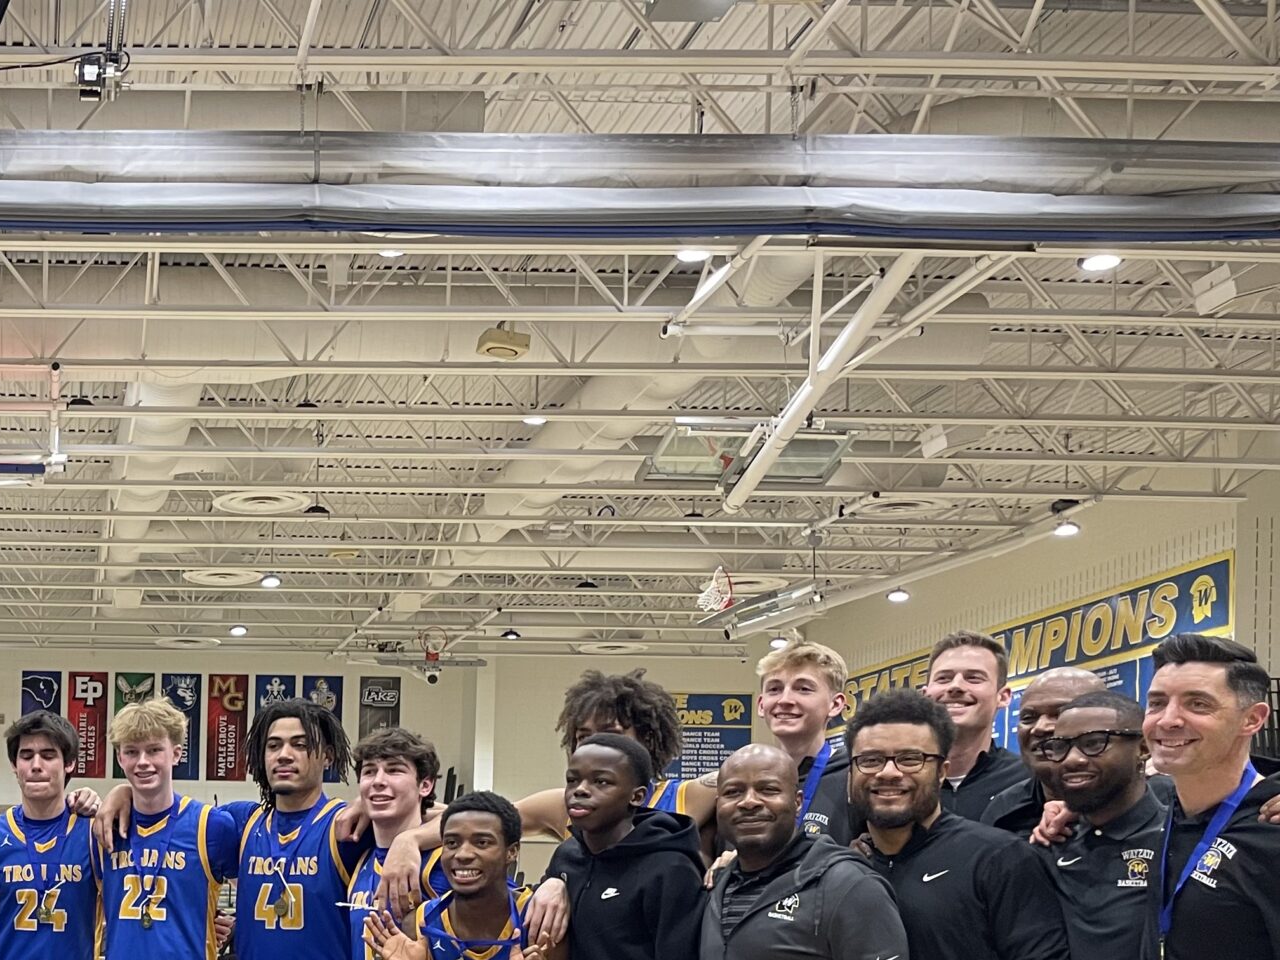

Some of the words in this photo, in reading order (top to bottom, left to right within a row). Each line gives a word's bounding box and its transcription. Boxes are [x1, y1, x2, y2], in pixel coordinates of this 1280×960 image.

[996, 582, 1179, 678] MPIONS
[364, 691, 397, 702] LAKE
[79, 713, 87, 749] PRAIRIE
[87, 726, 96, 761] EAGLES
[219, 715, 227, 745] GROVE
[227, 724, 236, 769] CRIMSON
[78, 753, 86, 774] EDEN
[218, 746, 227, 777] MAPLE
[1212, 837, 1238, 860] YZATA
[14, 888, 67, 932] 24
[119, 874, 167, 921] 22
[254, 883, 305, 930] 40
